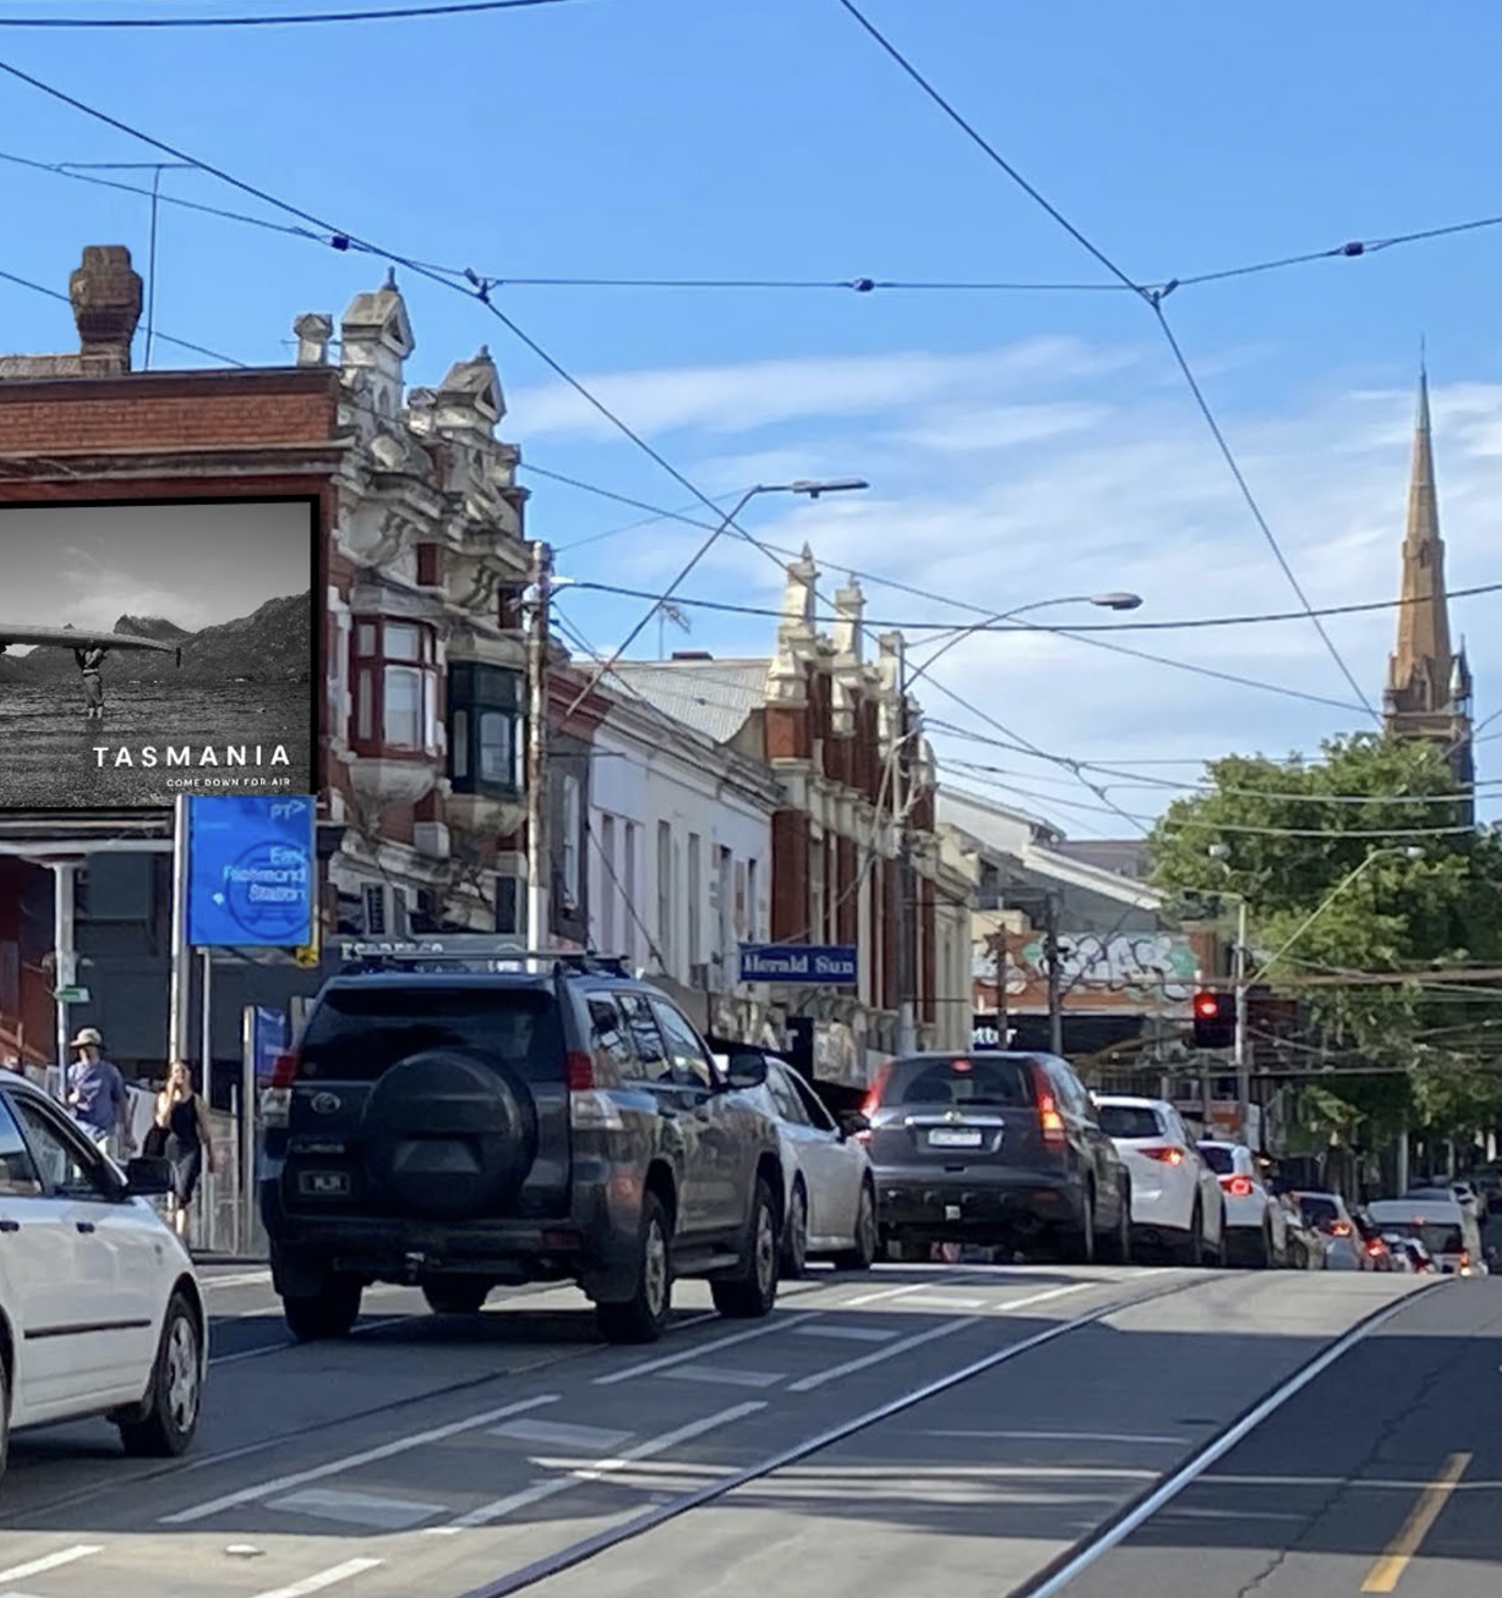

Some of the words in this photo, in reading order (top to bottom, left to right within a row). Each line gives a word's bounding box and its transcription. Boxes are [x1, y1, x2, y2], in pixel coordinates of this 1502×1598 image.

[92, 744, 291, 768] TASMANIA
[166, 778, 200, 787] COME
[204, 778, 240, 787] DOWN
[243, 777, 266, 786] FOR
[271, 777, 291, 786] AIR
[744, 954, 808, 974] Herald
[816, 955, 855, 974] Sun
